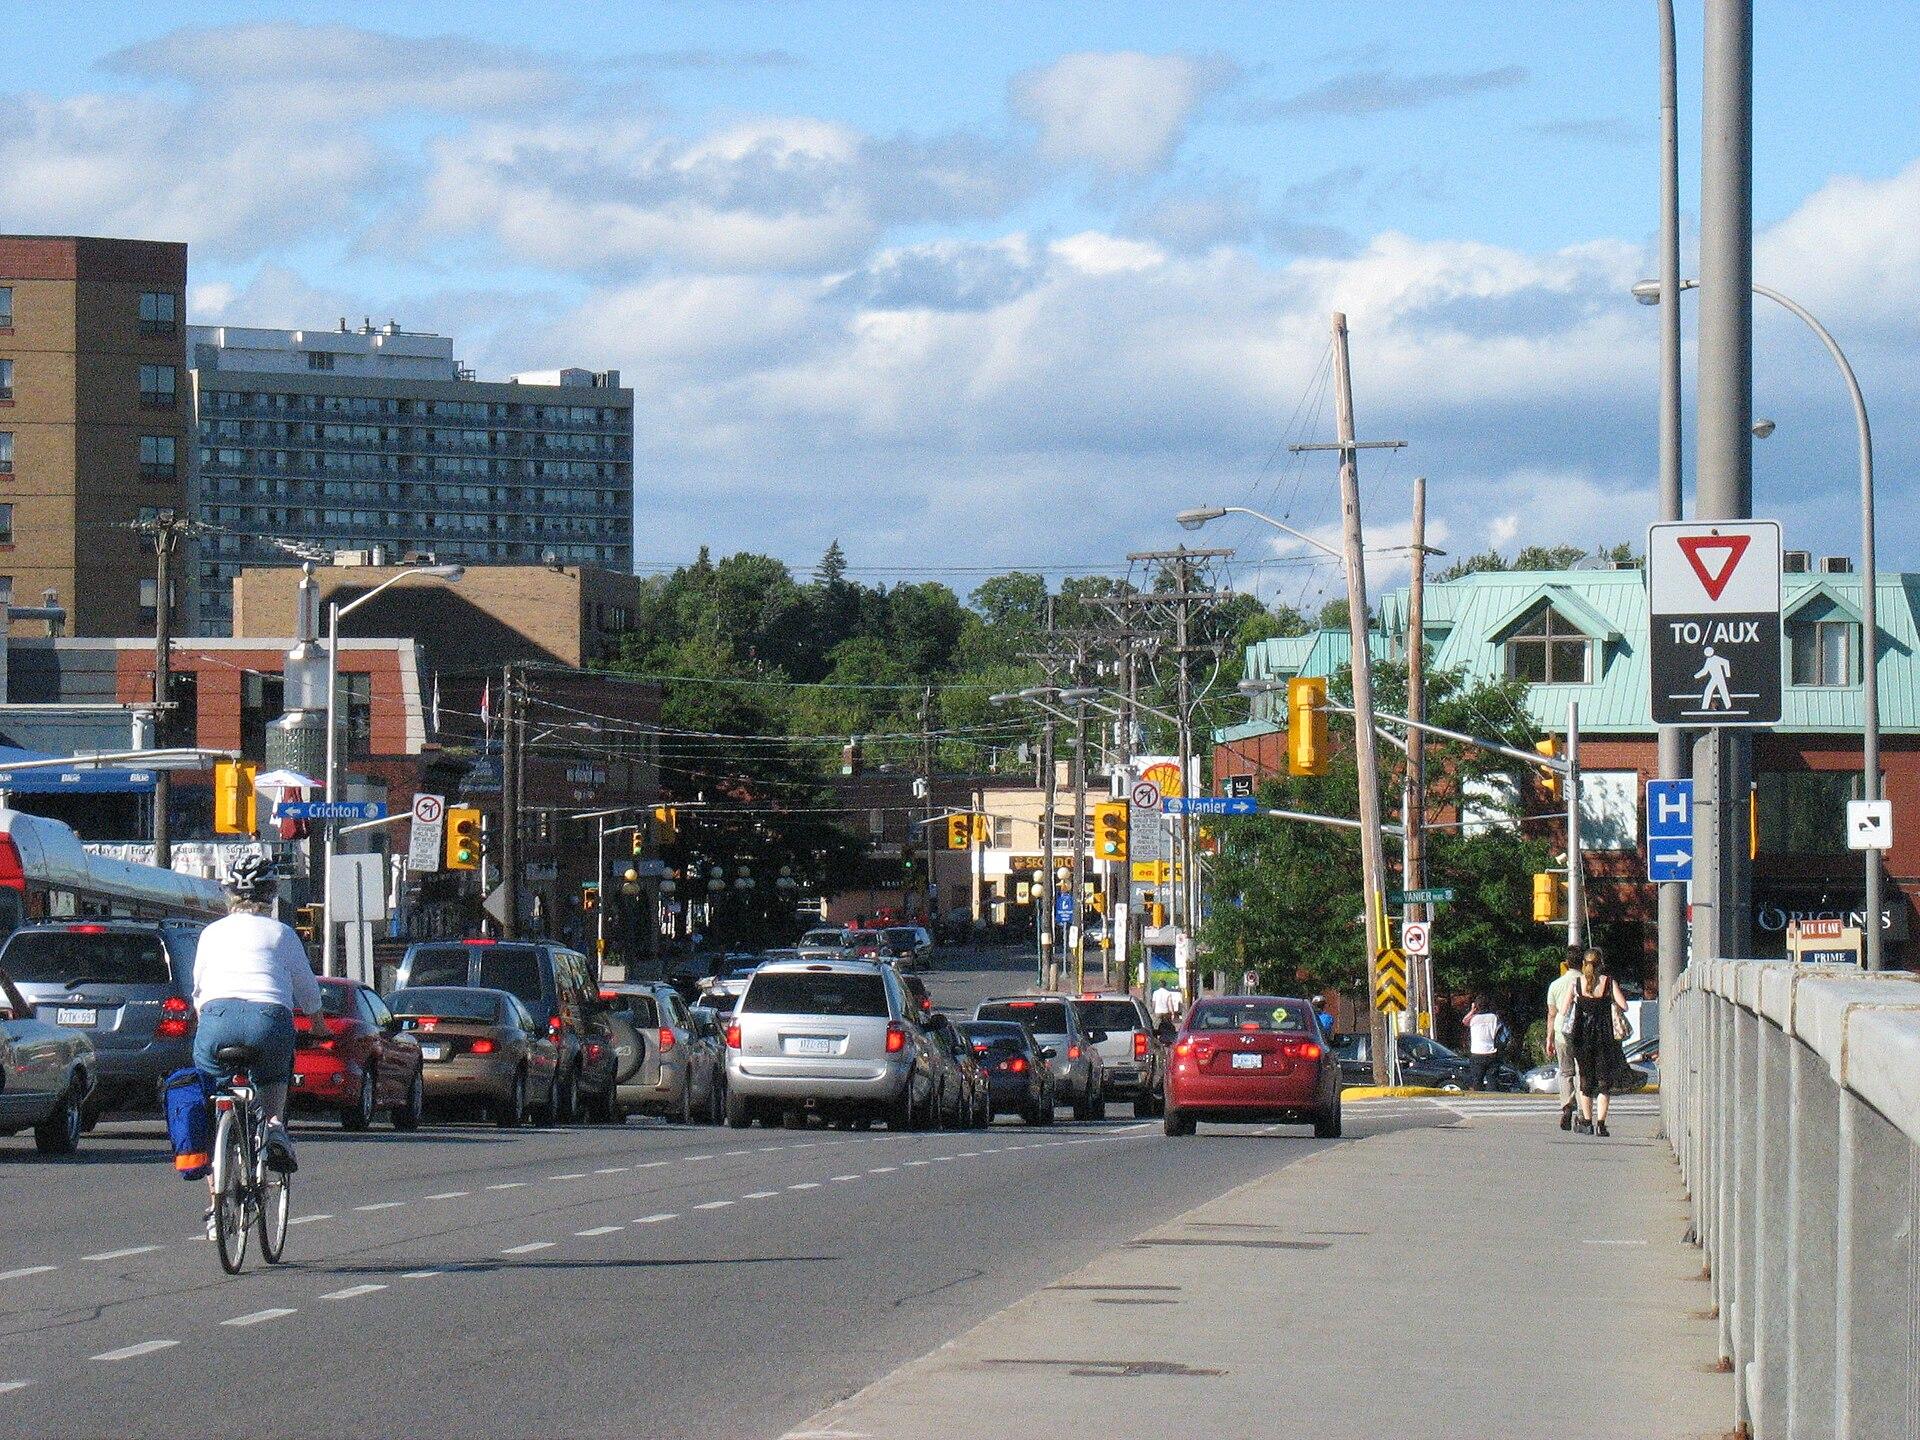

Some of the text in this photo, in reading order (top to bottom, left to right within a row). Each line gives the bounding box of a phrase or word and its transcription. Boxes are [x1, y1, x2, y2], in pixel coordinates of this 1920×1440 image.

[1669, 620, 1760, 646] TO/AUX
[308, 802, 359, 818] Crichton
[1187, 798, 1227, 814] Vanier
[1658, 792, 1687, 823] H
[1403, 890, 1432, 902] VANIER
[1813, 952, 1847, 963] PRIME
